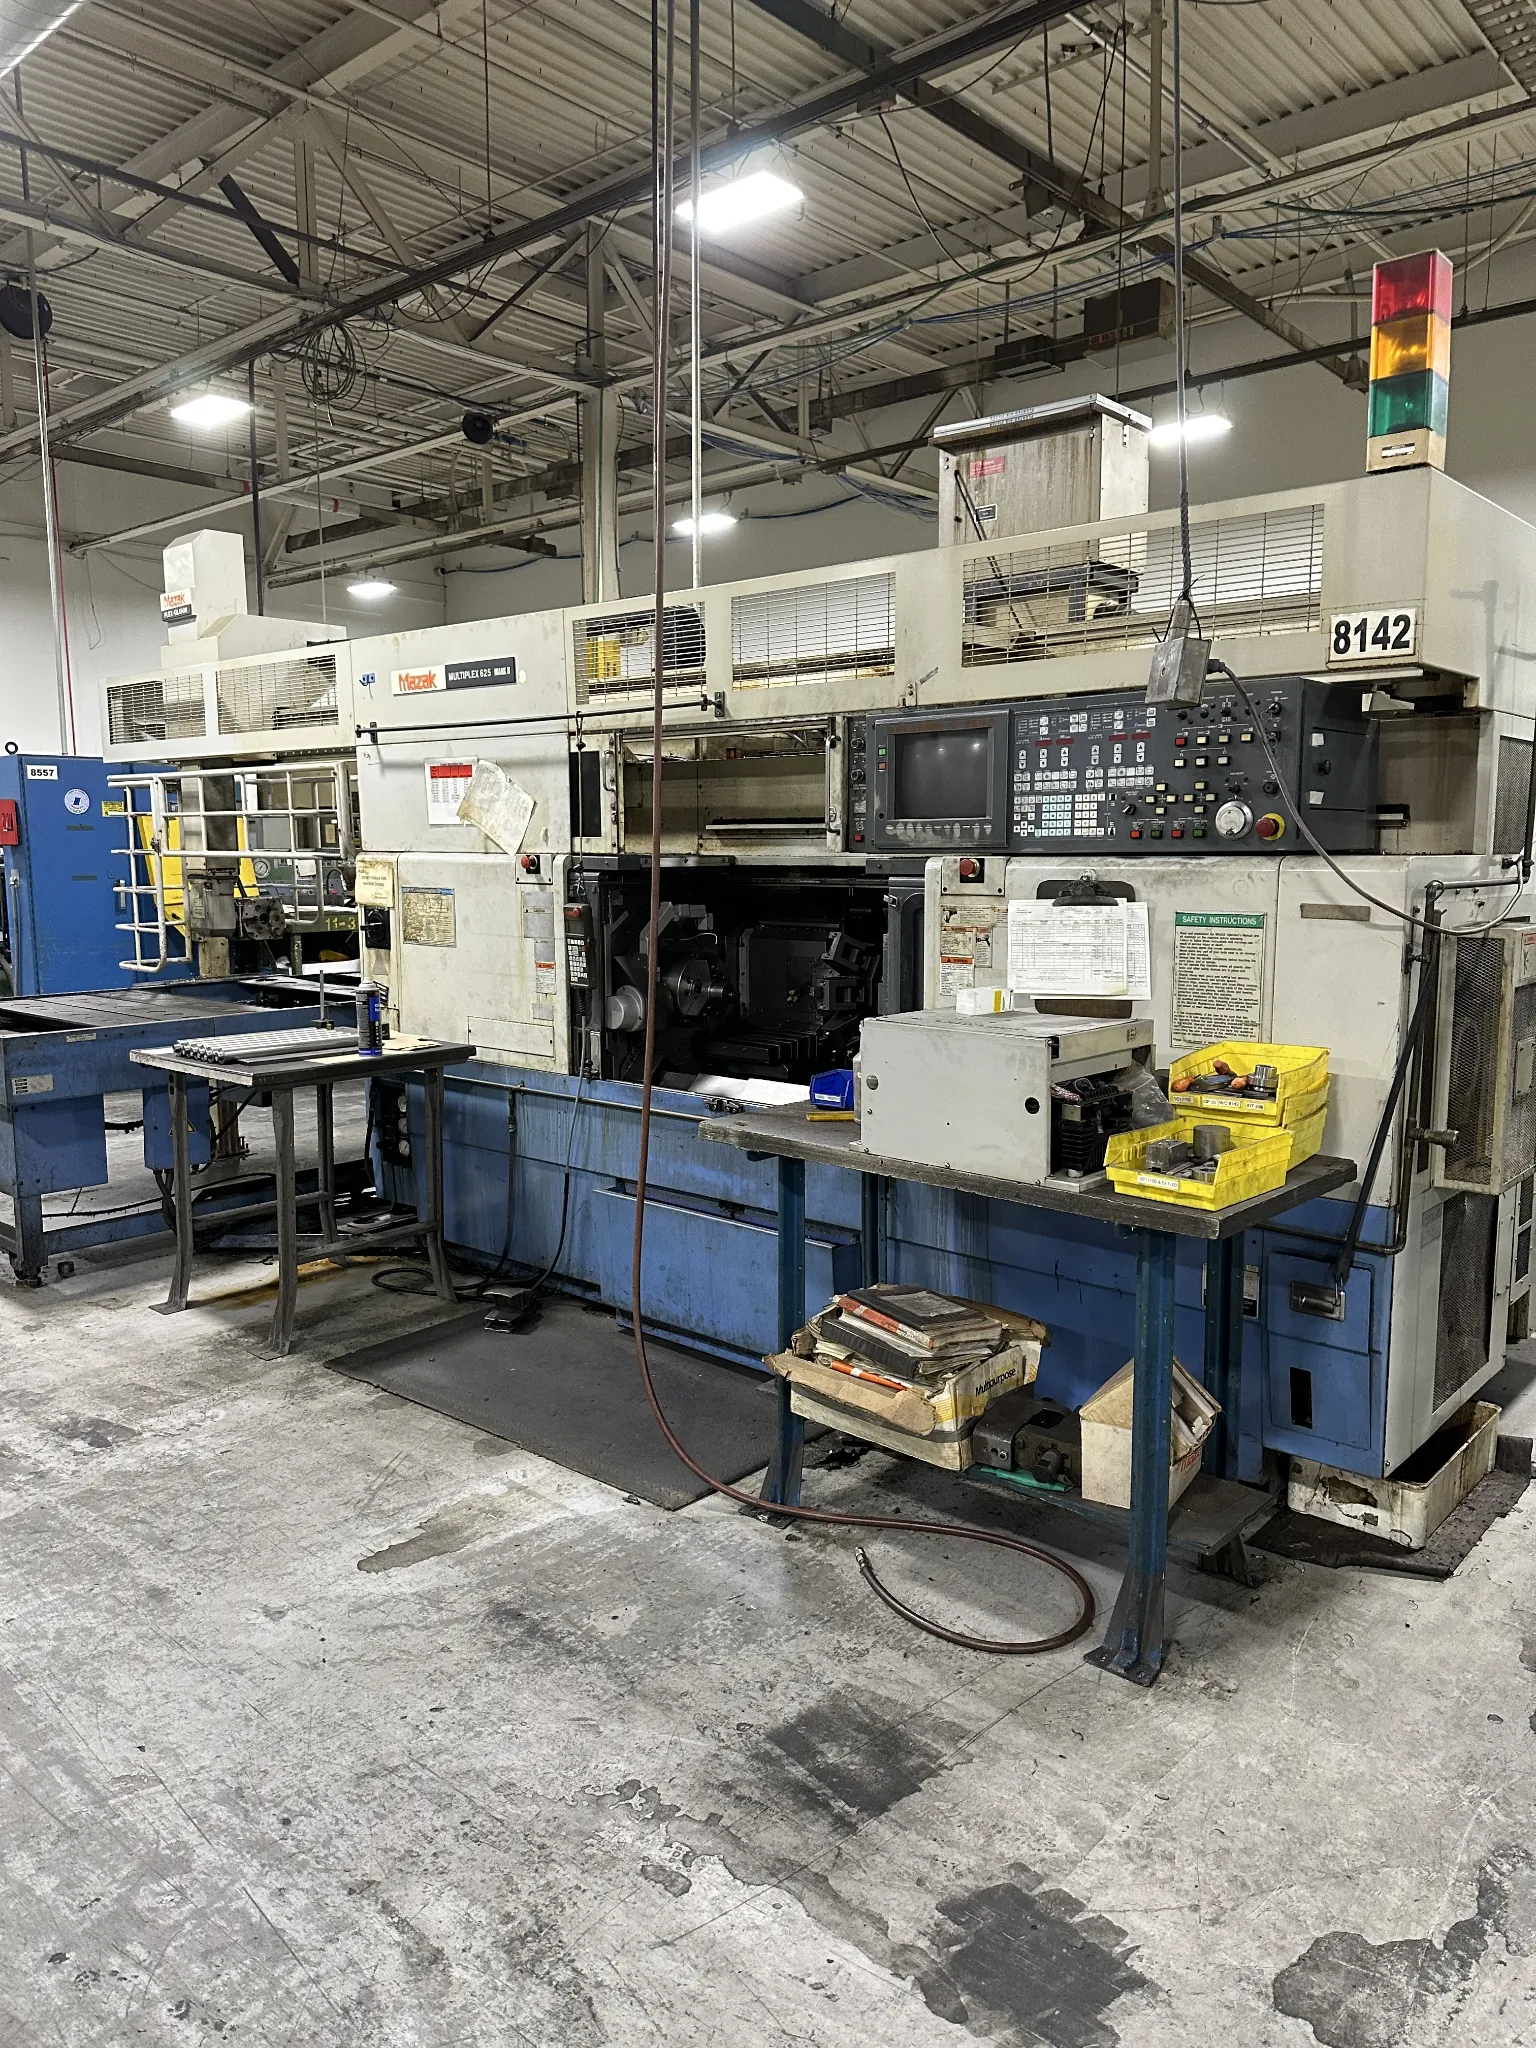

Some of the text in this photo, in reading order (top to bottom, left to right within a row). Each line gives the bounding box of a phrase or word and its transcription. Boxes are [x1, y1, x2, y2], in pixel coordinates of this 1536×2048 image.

[1334, 614, 1410, 654] 8142
[398, 670, 438, 691] Mazak
[448, 669, 480, 681] MULTIPLEX
[480, 668, 491, 678] 625
[1209, 916, 1256, 925] INSTRUCTIONS
[975, 1368, 1016, 1397] Multipurpose
